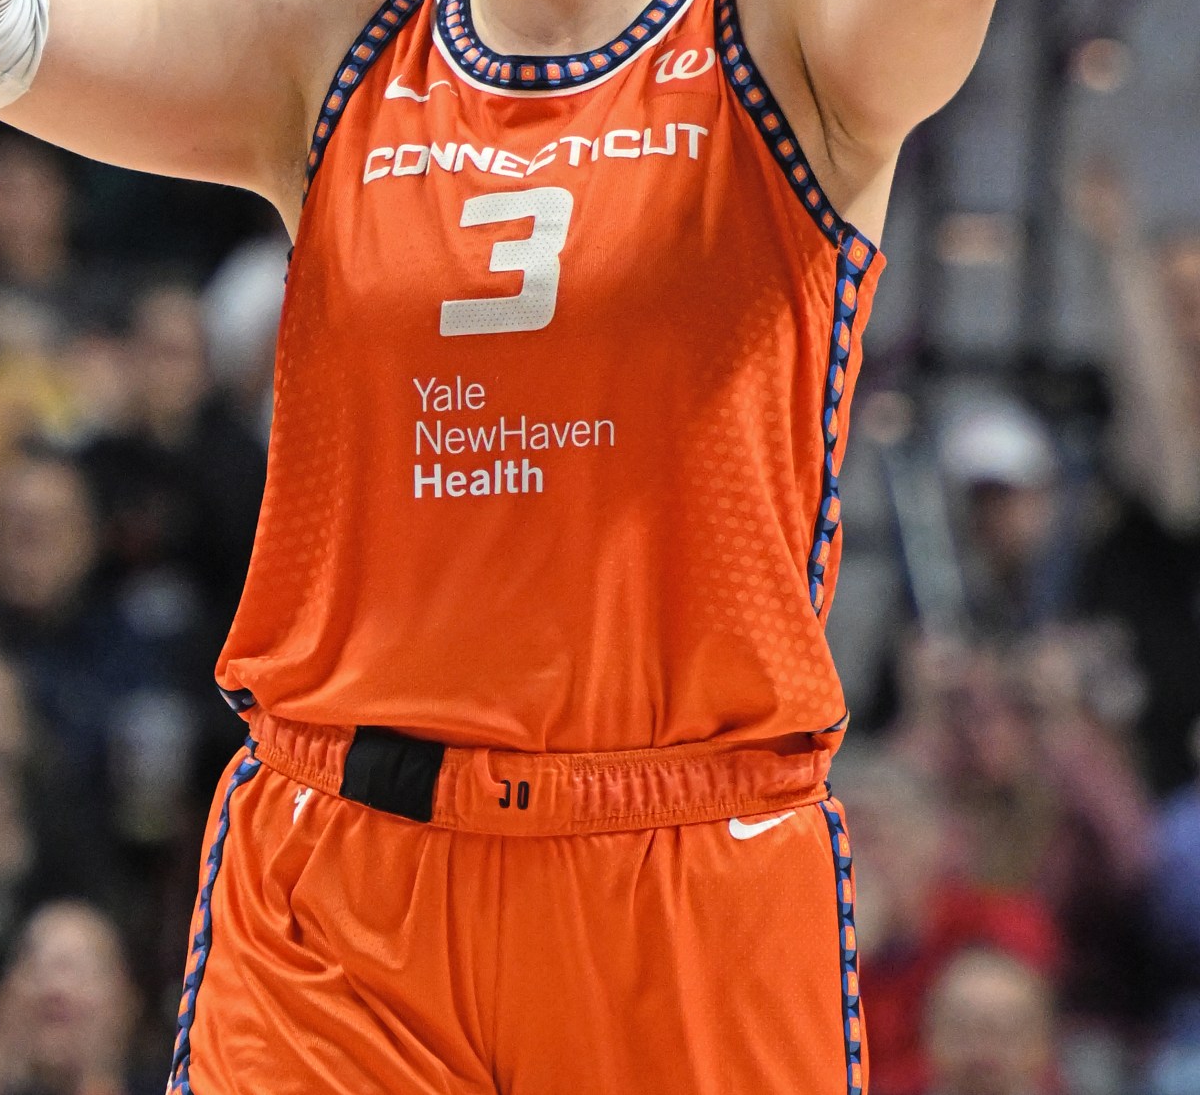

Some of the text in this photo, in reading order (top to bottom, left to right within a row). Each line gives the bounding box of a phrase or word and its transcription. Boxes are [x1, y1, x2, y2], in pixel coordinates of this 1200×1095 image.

[363, 123, 709, 184] CONNECTICUT
[440, 186, 574, 336] 3
[413, 375, 486, 412] Yale
[415, 415, 615, 455] NewHaven
[414, 459, 544, 498] Health
